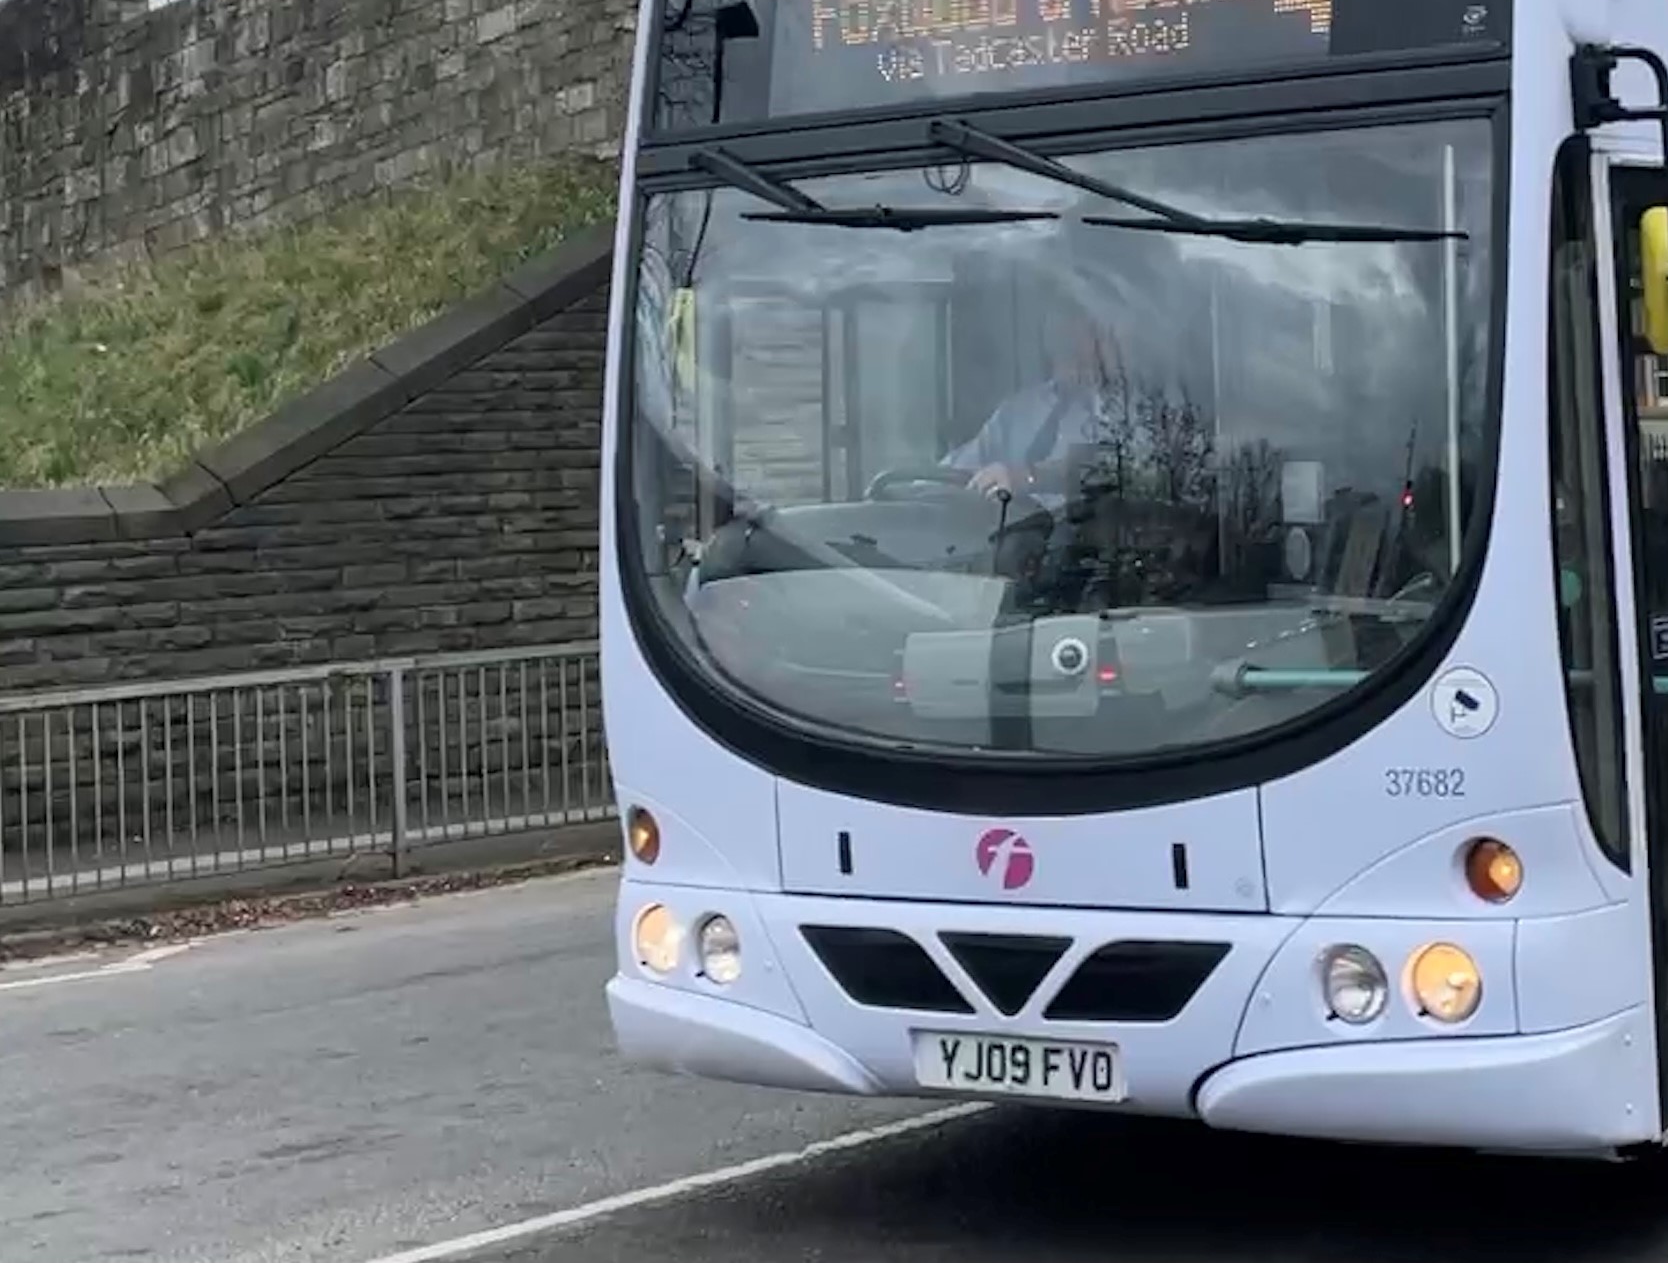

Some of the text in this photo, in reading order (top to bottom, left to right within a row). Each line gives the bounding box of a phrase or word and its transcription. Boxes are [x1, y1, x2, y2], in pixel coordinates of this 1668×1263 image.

[876, 10, 1191, 81] via Tadcaster Road
[1384, 768, 1466, 797] 37682
[939, 1039, 1031, 1085] YJ09
